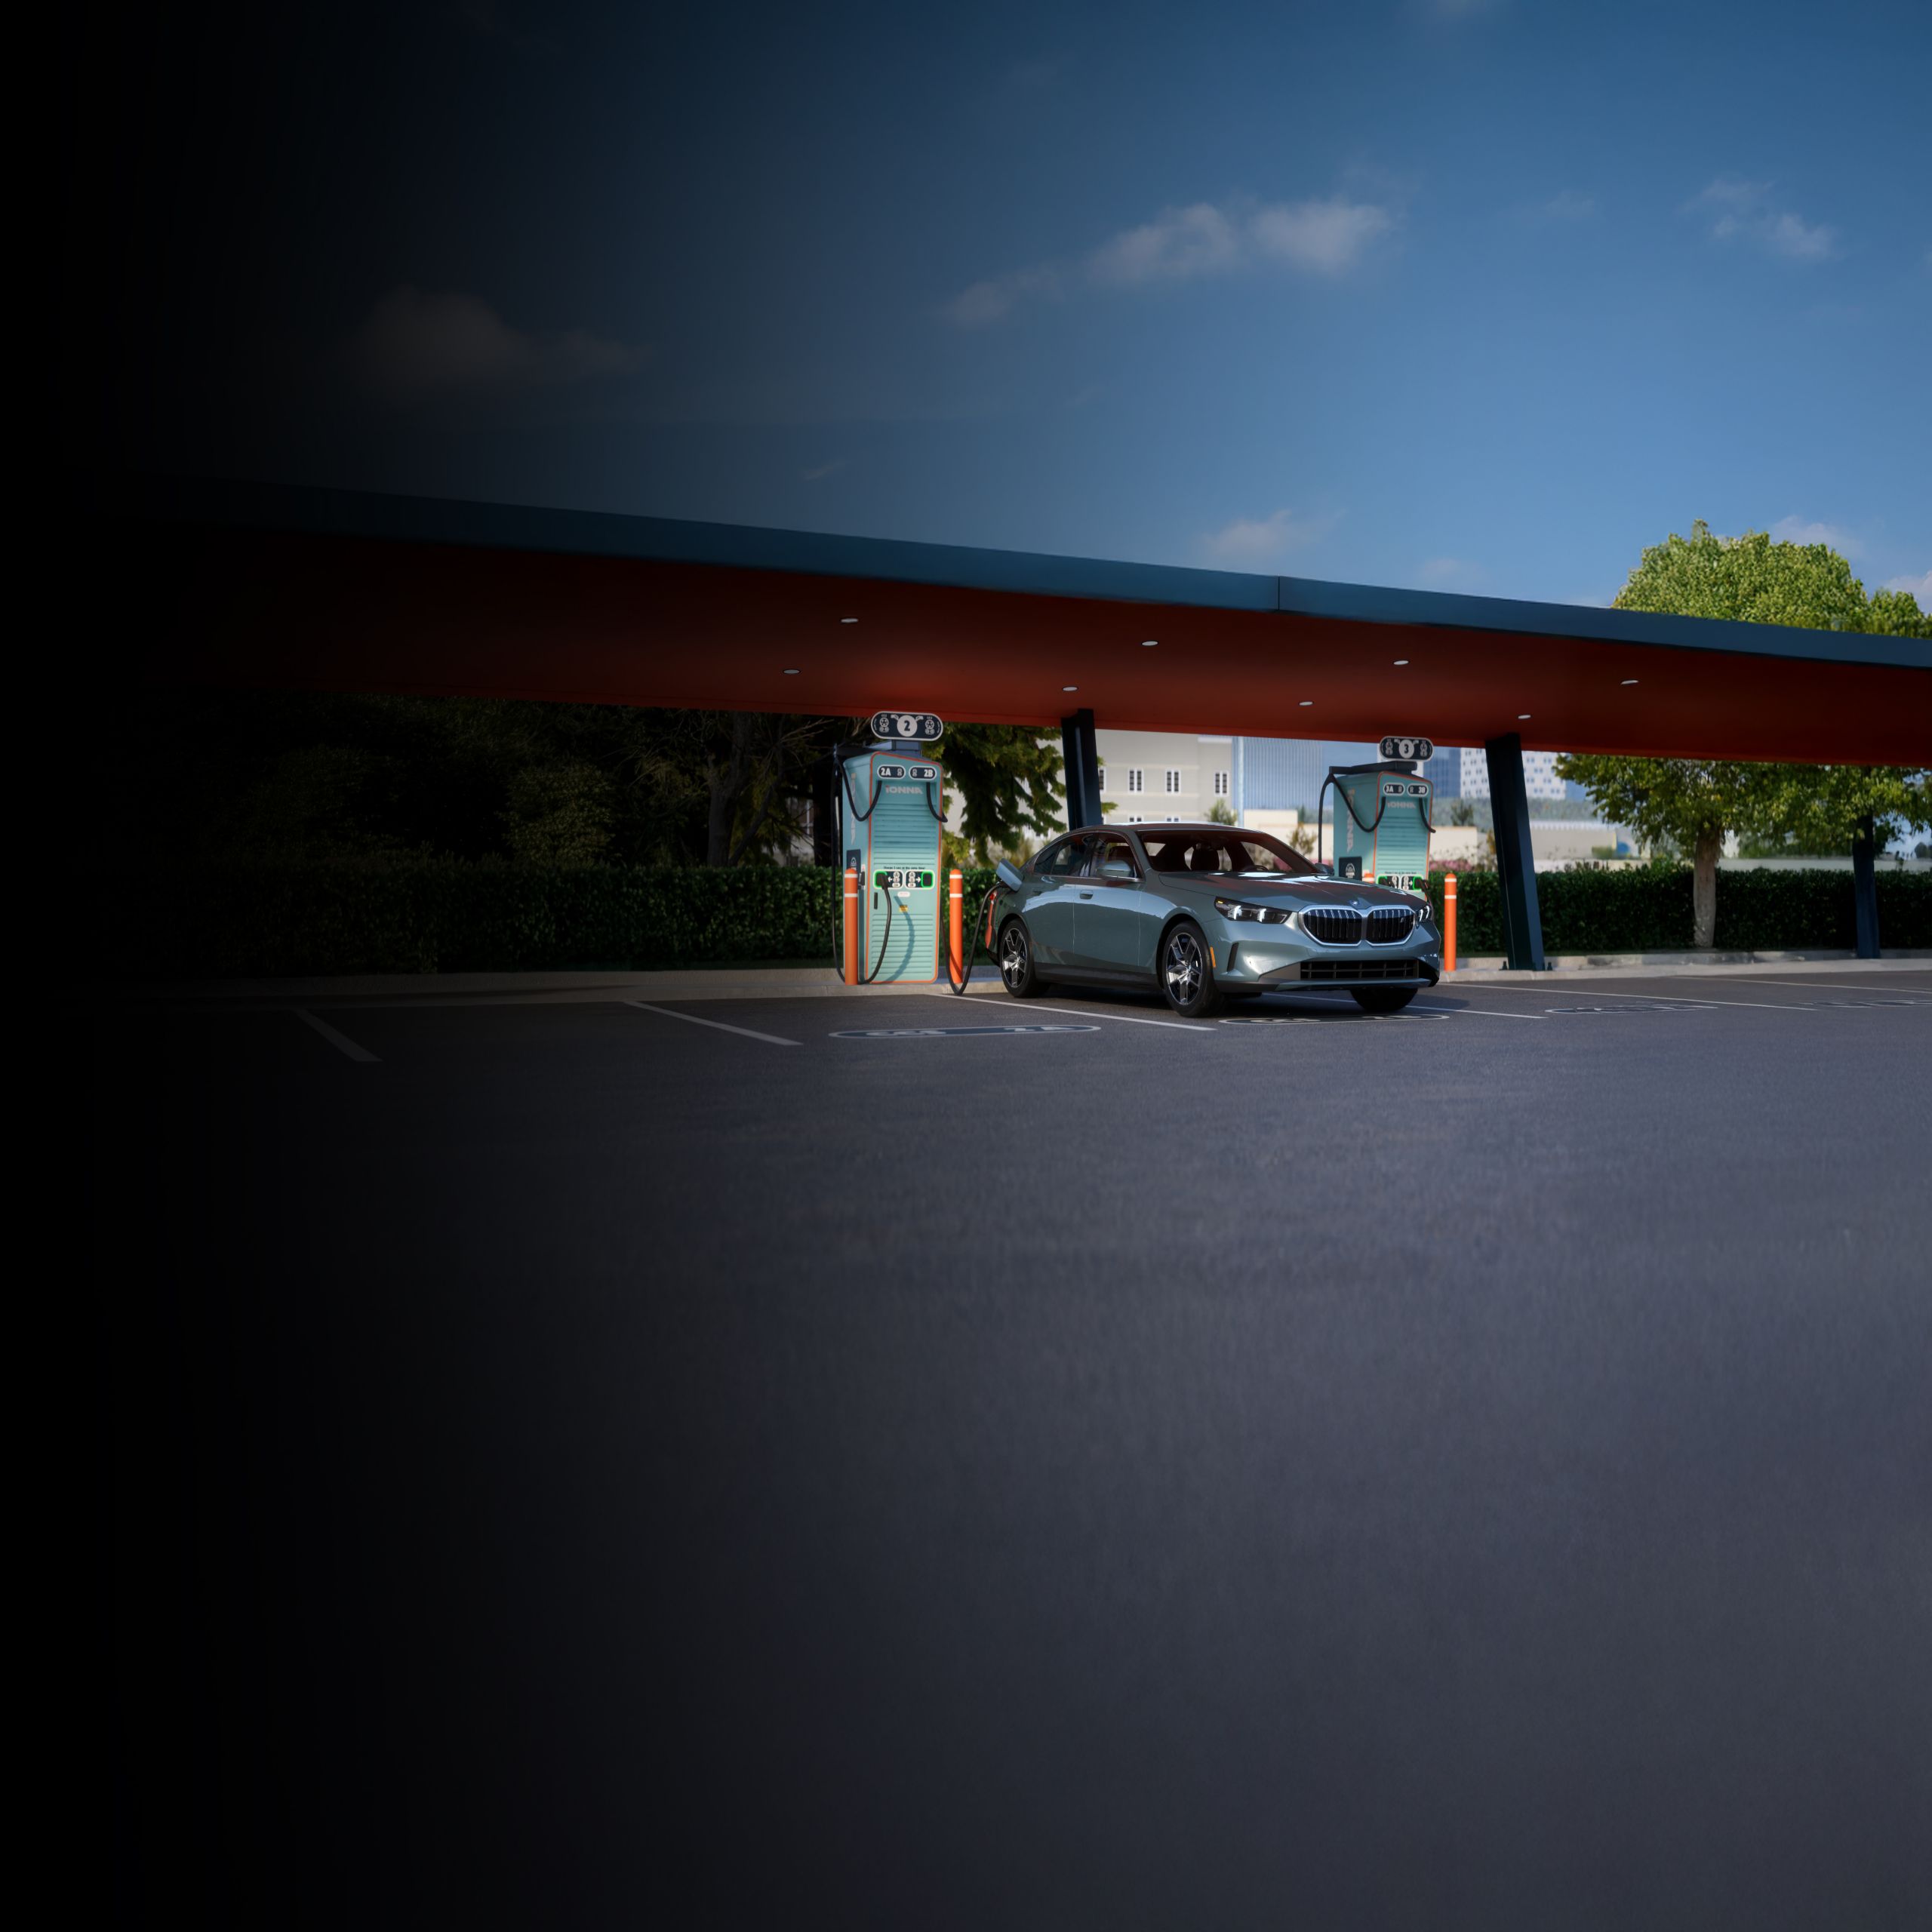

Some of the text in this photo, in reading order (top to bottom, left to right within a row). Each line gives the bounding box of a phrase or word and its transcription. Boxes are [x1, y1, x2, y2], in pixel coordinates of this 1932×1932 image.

[903, 720, 911, 732] 2
[1404, 744, 1409, 754] 3
[881, 768, 891, 777] 2A
[924, 769, 934, 778] 2B
[1386, 785, 1394, 793] 3A
